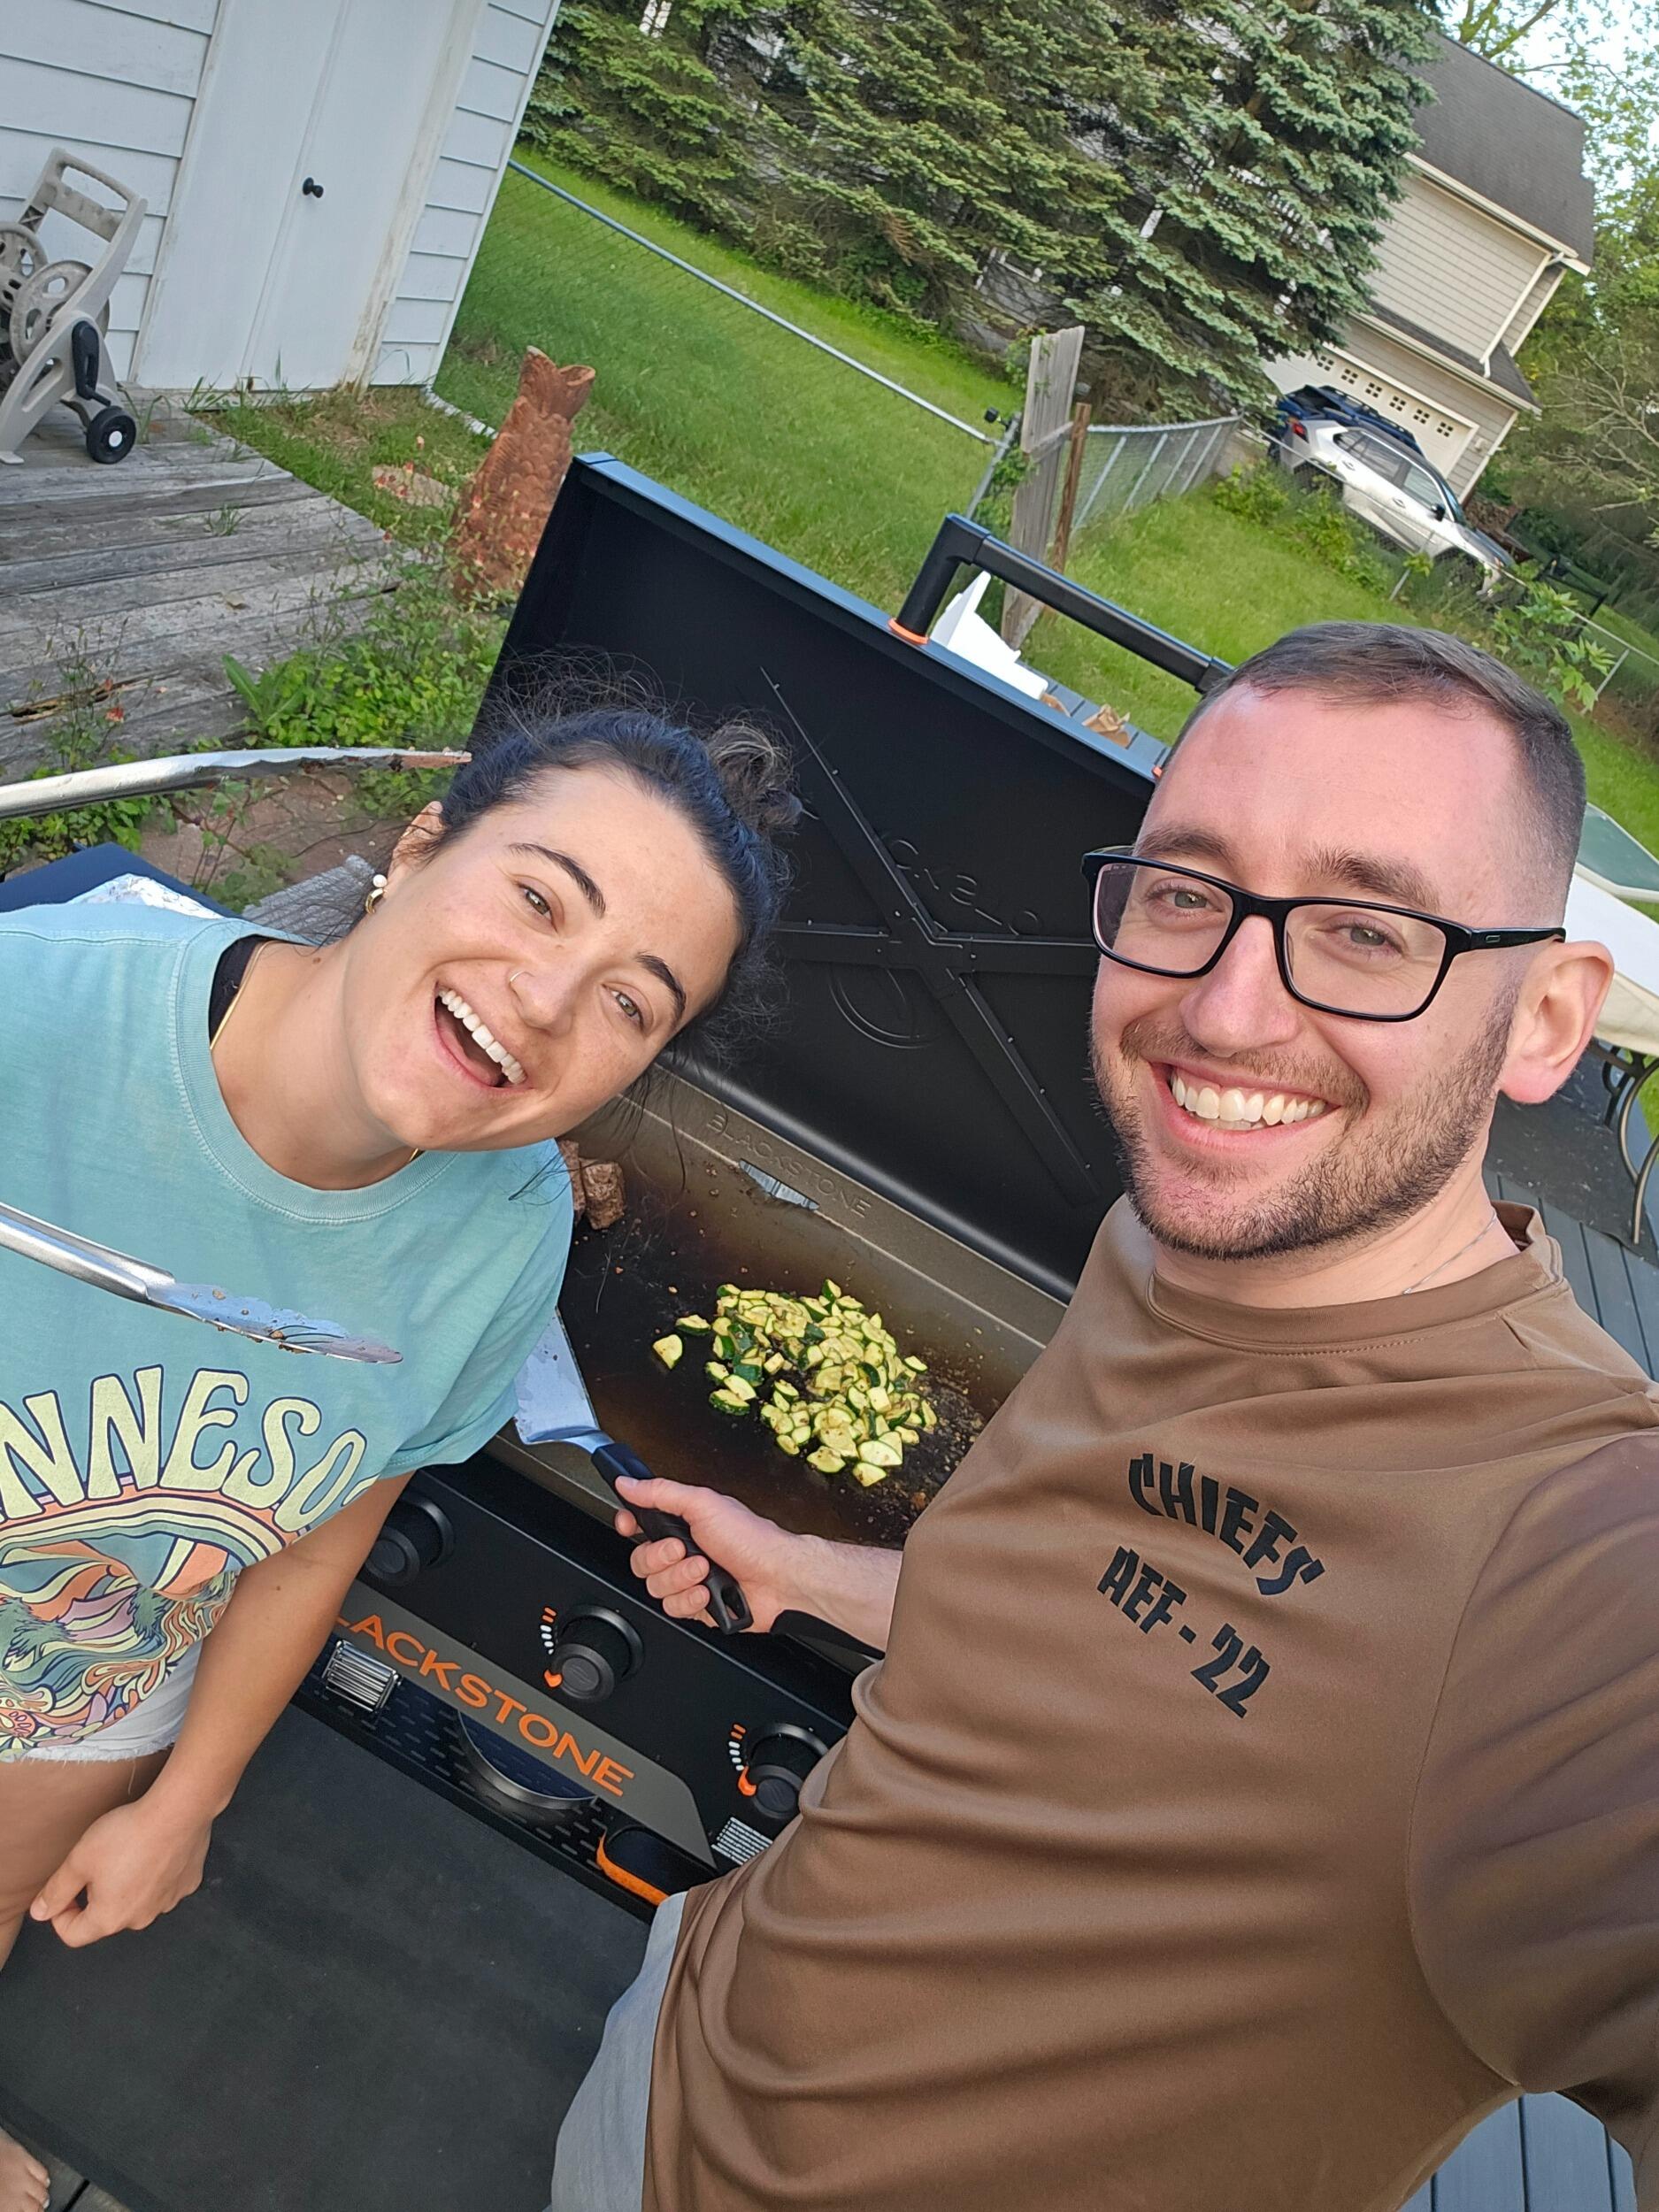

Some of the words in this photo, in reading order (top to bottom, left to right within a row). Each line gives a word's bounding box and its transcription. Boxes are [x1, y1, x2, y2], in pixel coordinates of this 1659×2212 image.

[706, 1113, 871, 1217] BLACKSTONE
[0, 1364, 380, 1534] NNESO
[1097, 1546, 1187, 1634] AEF
[1190, 1623, 1271, 1718] 22
